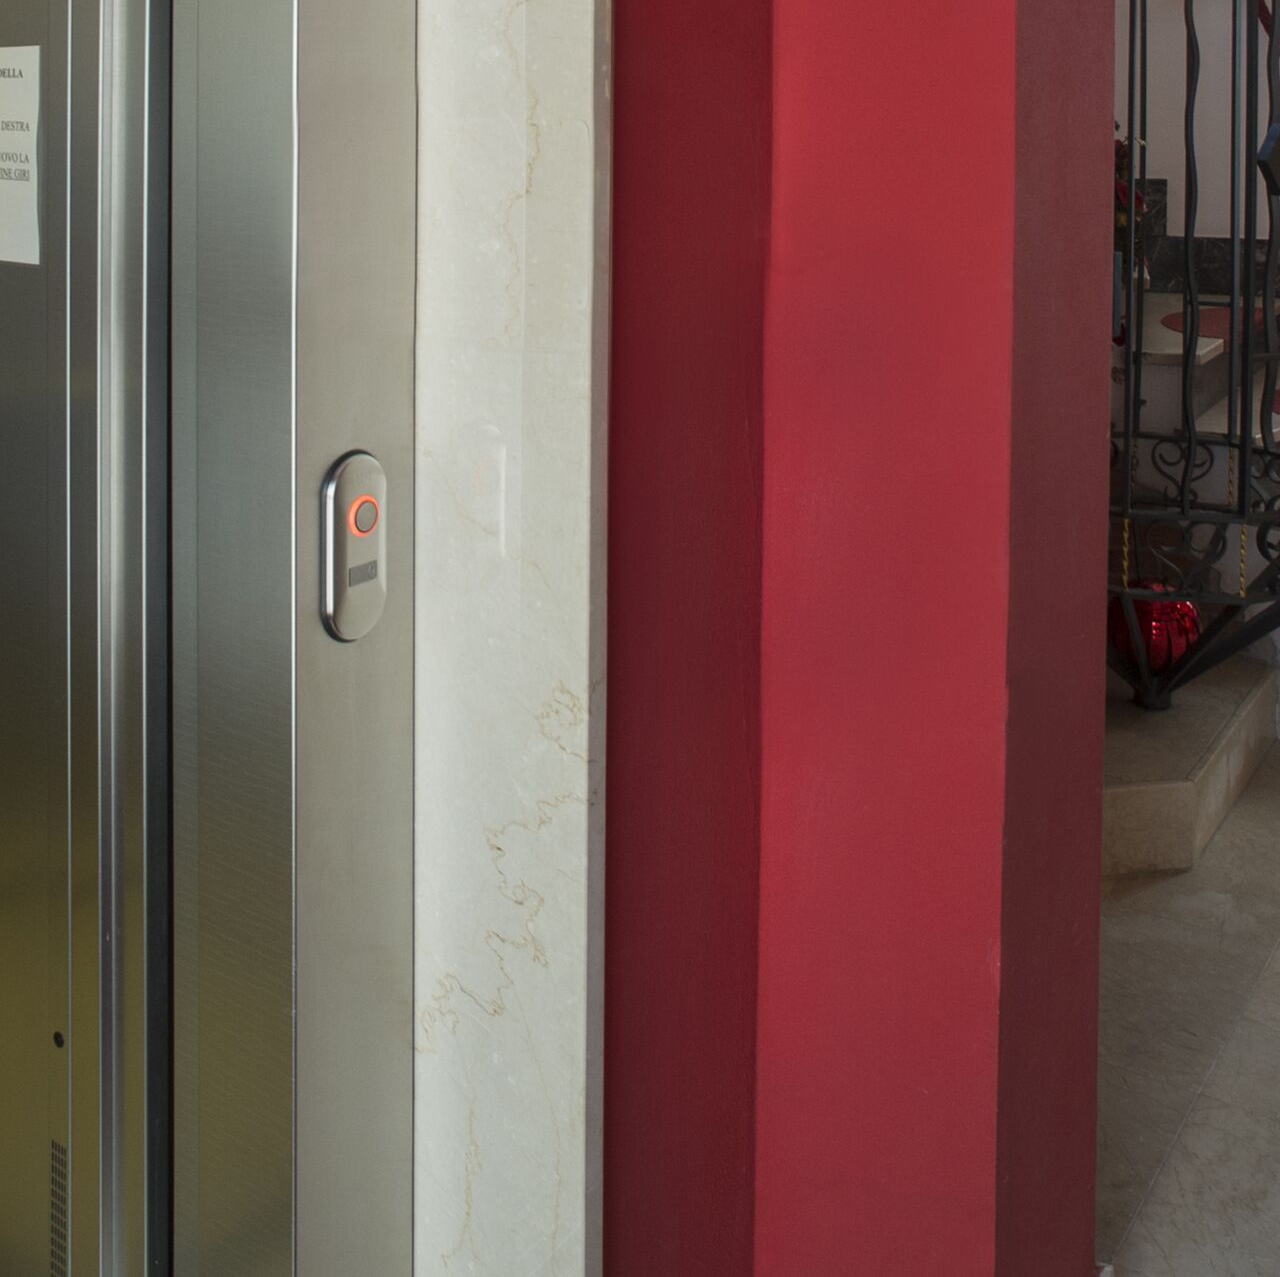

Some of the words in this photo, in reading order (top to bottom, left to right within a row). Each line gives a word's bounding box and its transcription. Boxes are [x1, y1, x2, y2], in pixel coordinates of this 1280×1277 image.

[1, 121, 30, 132] DESTRA
[19, 153, 30, 163] LA
[14, 170, 29, 180] GIRI
